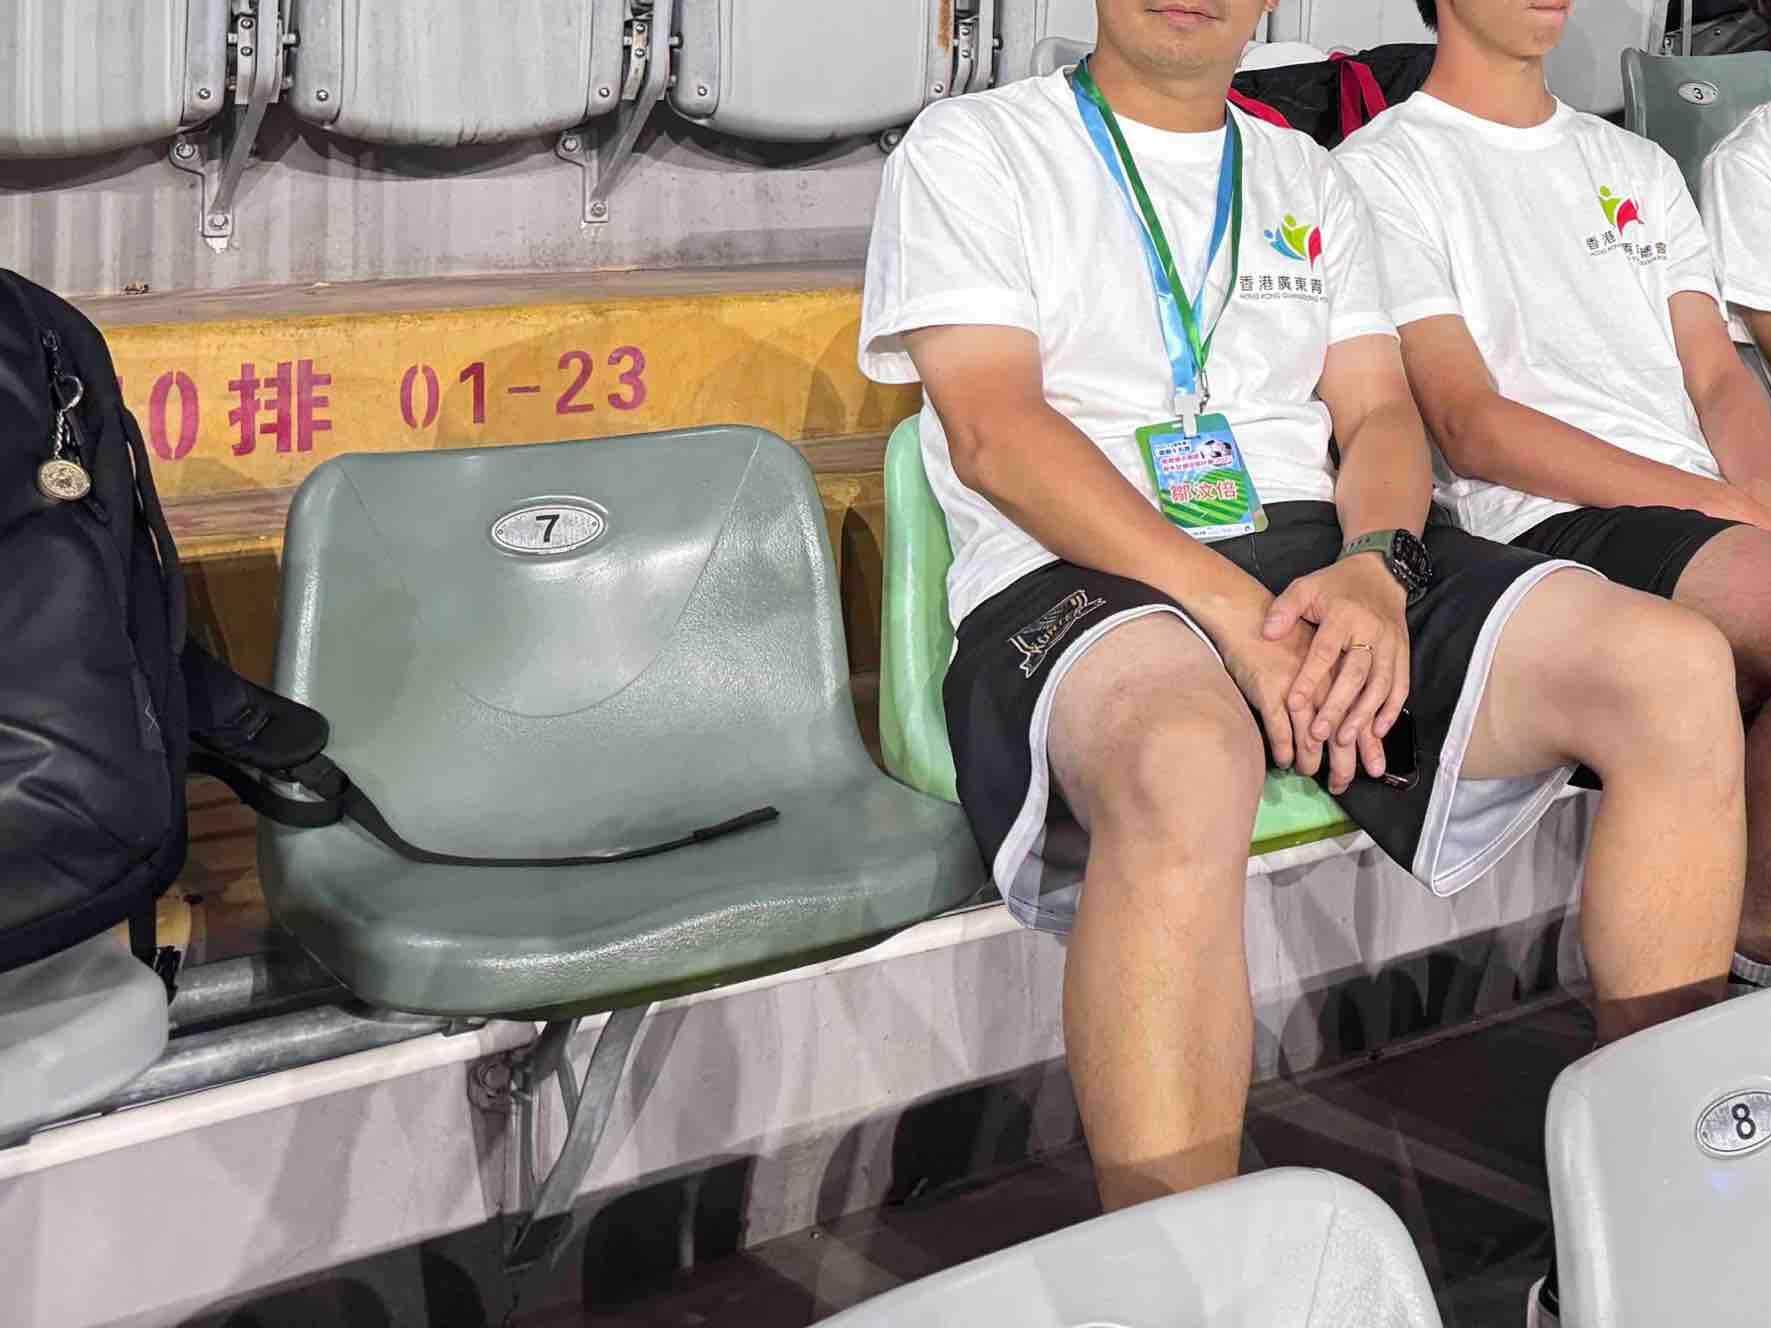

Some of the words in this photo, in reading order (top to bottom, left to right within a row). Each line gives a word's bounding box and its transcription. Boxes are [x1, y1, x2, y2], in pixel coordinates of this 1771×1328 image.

[1693, 87, 1704, 101] 3
[400, 345, 647, 430] 01-23
[536, 514, 560, 543] 7
[1731, 1103, 1757, 1140] 8
